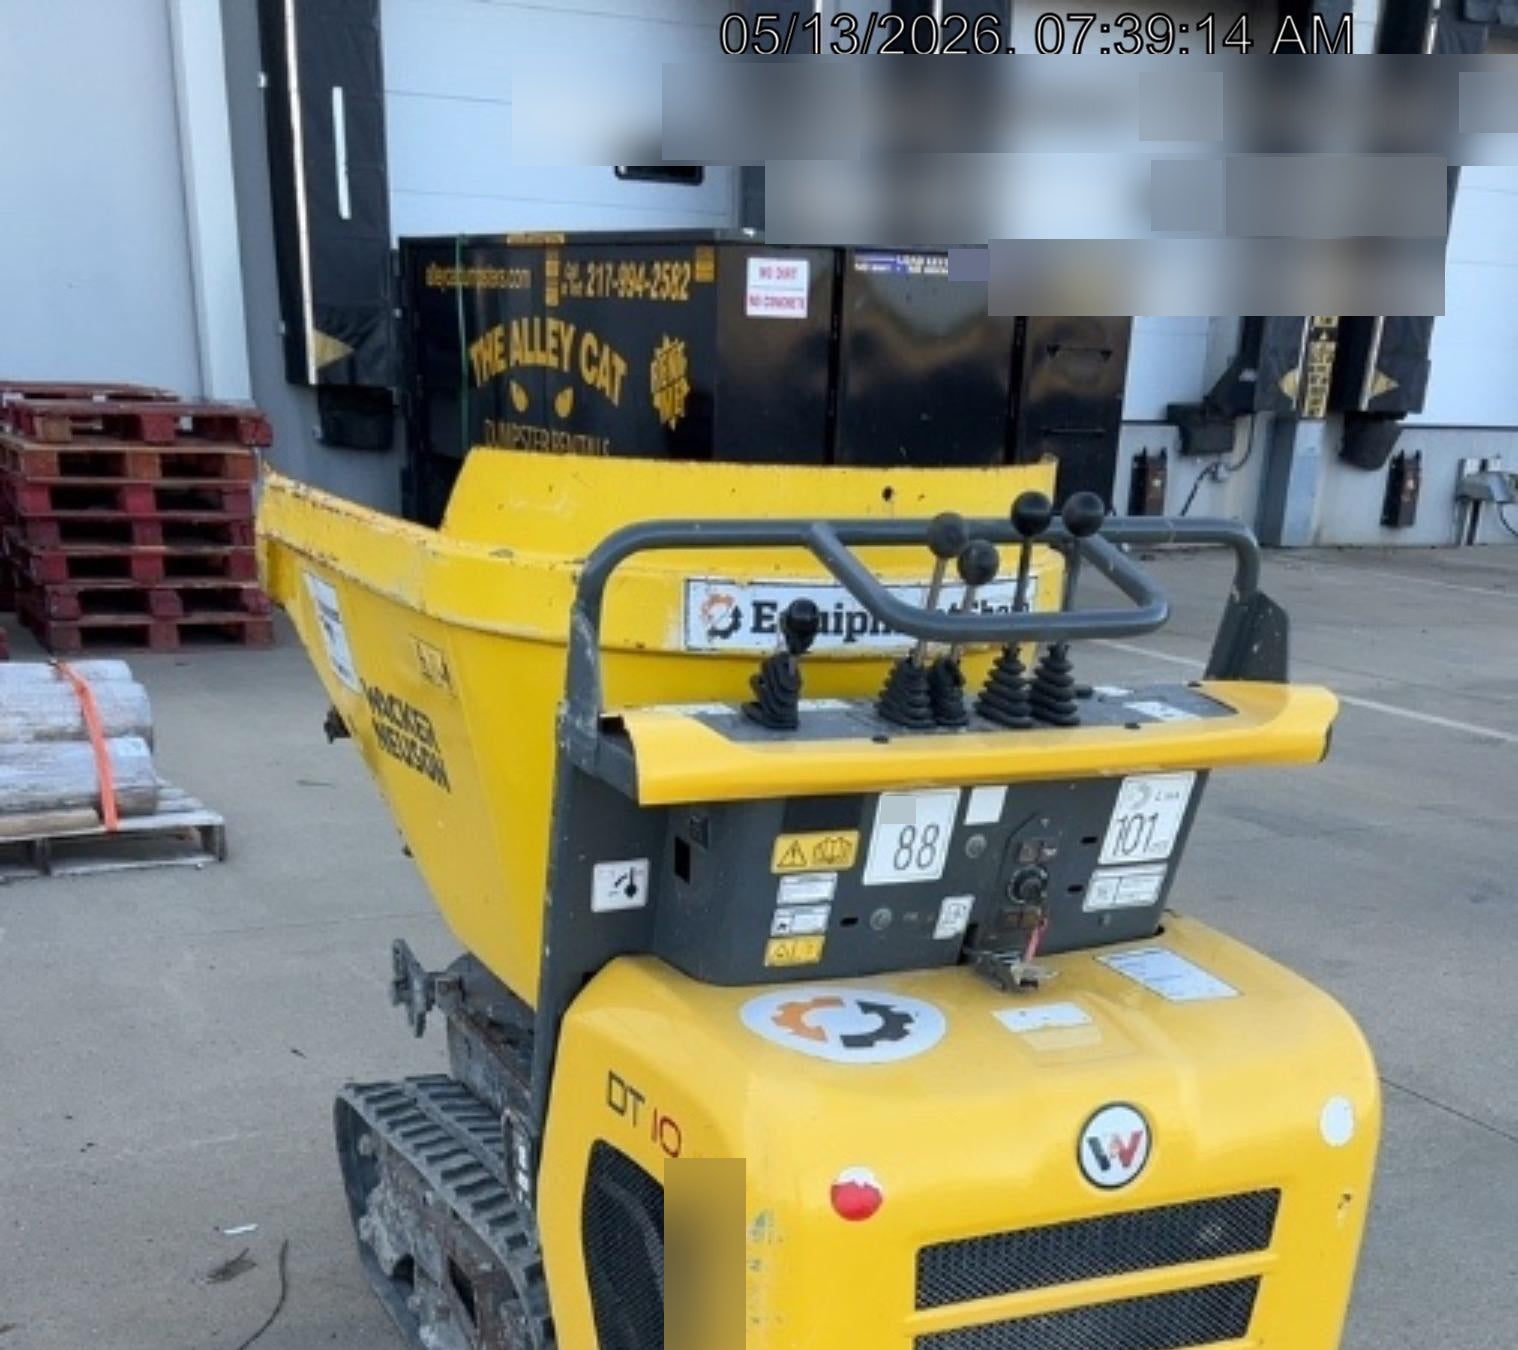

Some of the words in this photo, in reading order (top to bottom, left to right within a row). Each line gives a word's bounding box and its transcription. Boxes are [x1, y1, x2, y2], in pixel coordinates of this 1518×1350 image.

[470, 324, 507, 388] THE
[508, 317, 576, 373] ALLEY
[580, 332, 627, 407] CAT
[894, 823, 940, 871] 88
[1112, 811, 1159, 856] 101
[606, 1069, 646, 1128] DT
[650, 1106, 682, 1158] 10
